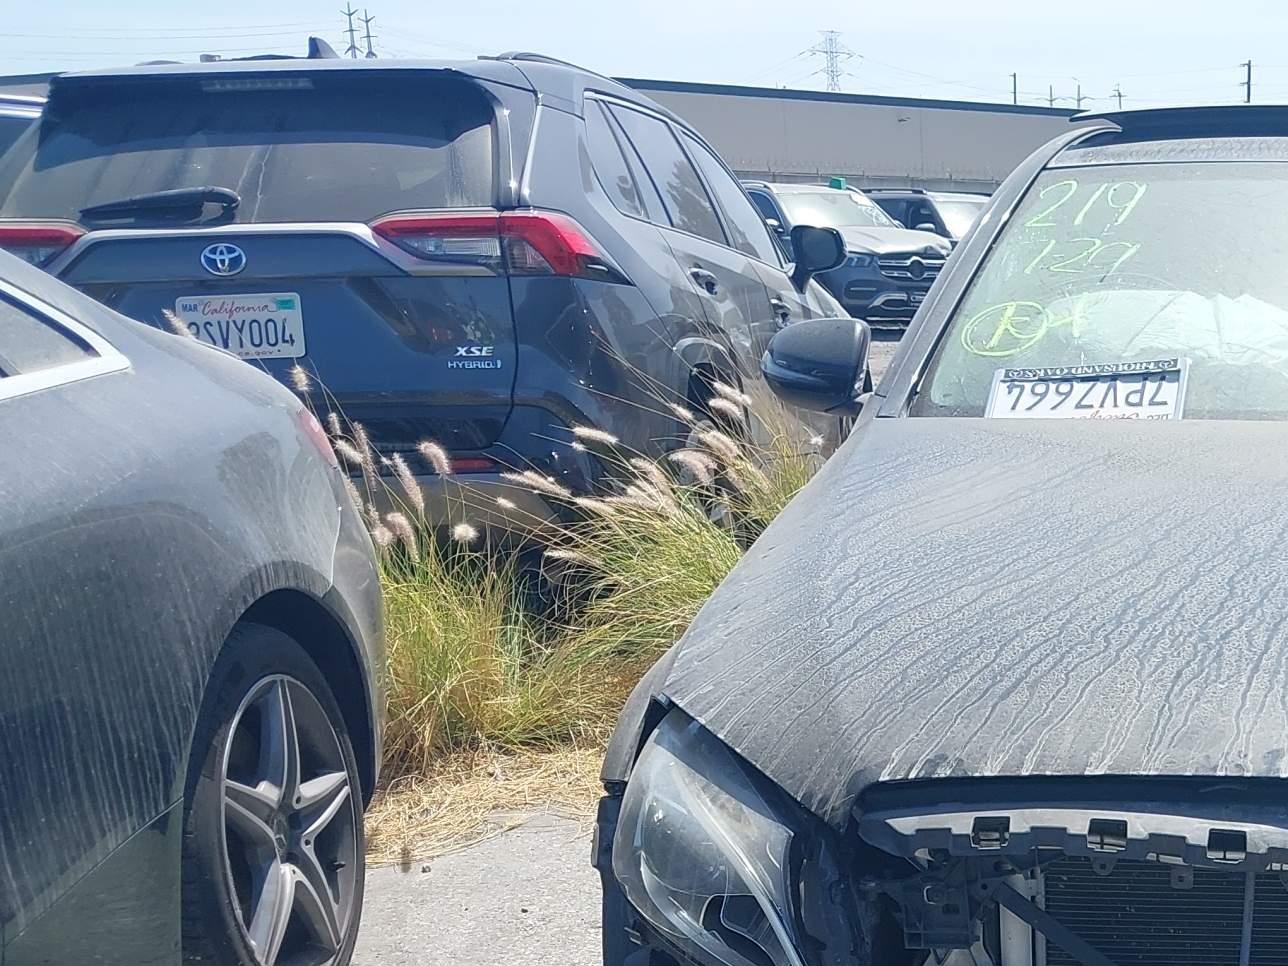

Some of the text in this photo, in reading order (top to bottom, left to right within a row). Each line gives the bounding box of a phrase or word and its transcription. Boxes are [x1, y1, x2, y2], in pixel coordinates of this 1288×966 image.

[1024, 179, 1148, 227] 219
[181, 300, 277, 319] MAR California
[453, 346, 494, 357] XSE
[447, 360, 495, 369] HYBRID
[1025, 361, 1159, 379] THOUSAND OAKS
[1006, 375, 1169, 411] 7PVZ664
